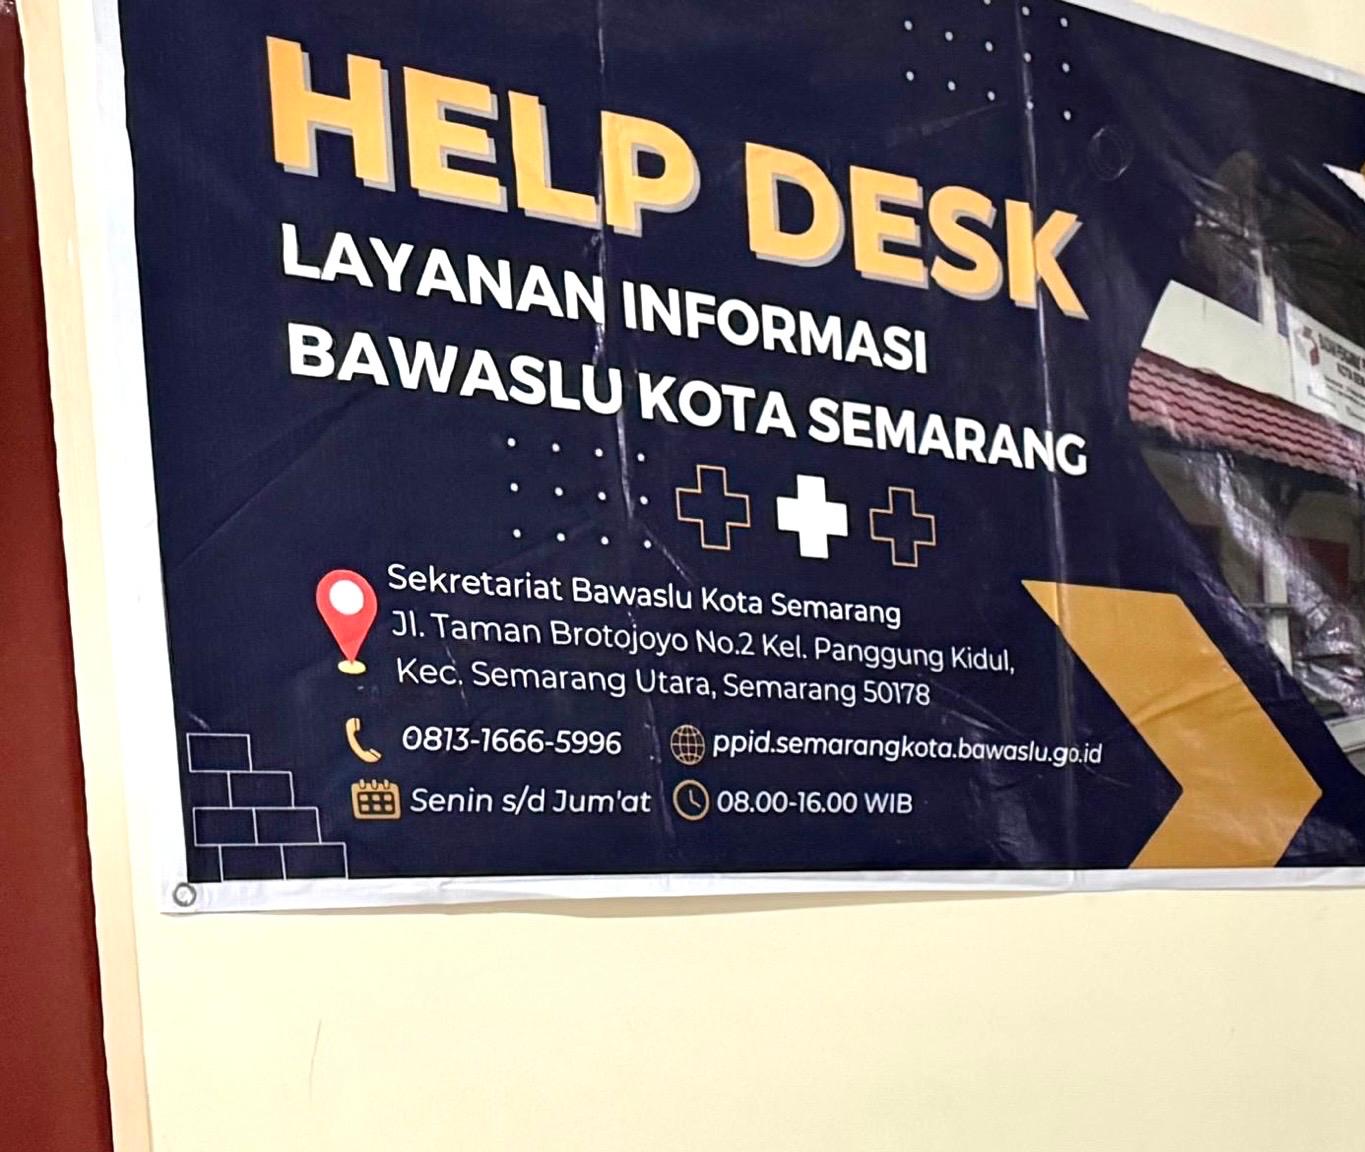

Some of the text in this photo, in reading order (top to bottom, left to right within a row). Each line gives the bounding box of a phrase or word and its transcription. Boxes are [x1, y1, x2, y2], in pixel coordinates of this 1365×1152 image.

[265, 35, 1090, 321] HELP DESK
[280, 221, 927, 375] LAYANAN INFORMASI
[287, 322, 1087, 477] BAWASLU KOTA SEMARANG
[387, 564, 901, 627] Sekretariat Bawaslu Kota Semarang
[392, 611, 1015, 674] Jl. Taman Brotojoyo No.2 Kel. Panggung Kidul,
[398, 658, 930, 707] Kec. Semarang Utara, Semarang 50178
[402, 726, 622, 755] 0813-1666-5996
[712, 729, 1102, 767] ppid.semarangkota.bawaslu.go.id
[410, 785, 651, 814] Senin s/d Jum'at
[716, 790, 913, 813] 08.00-16.00 WIB
